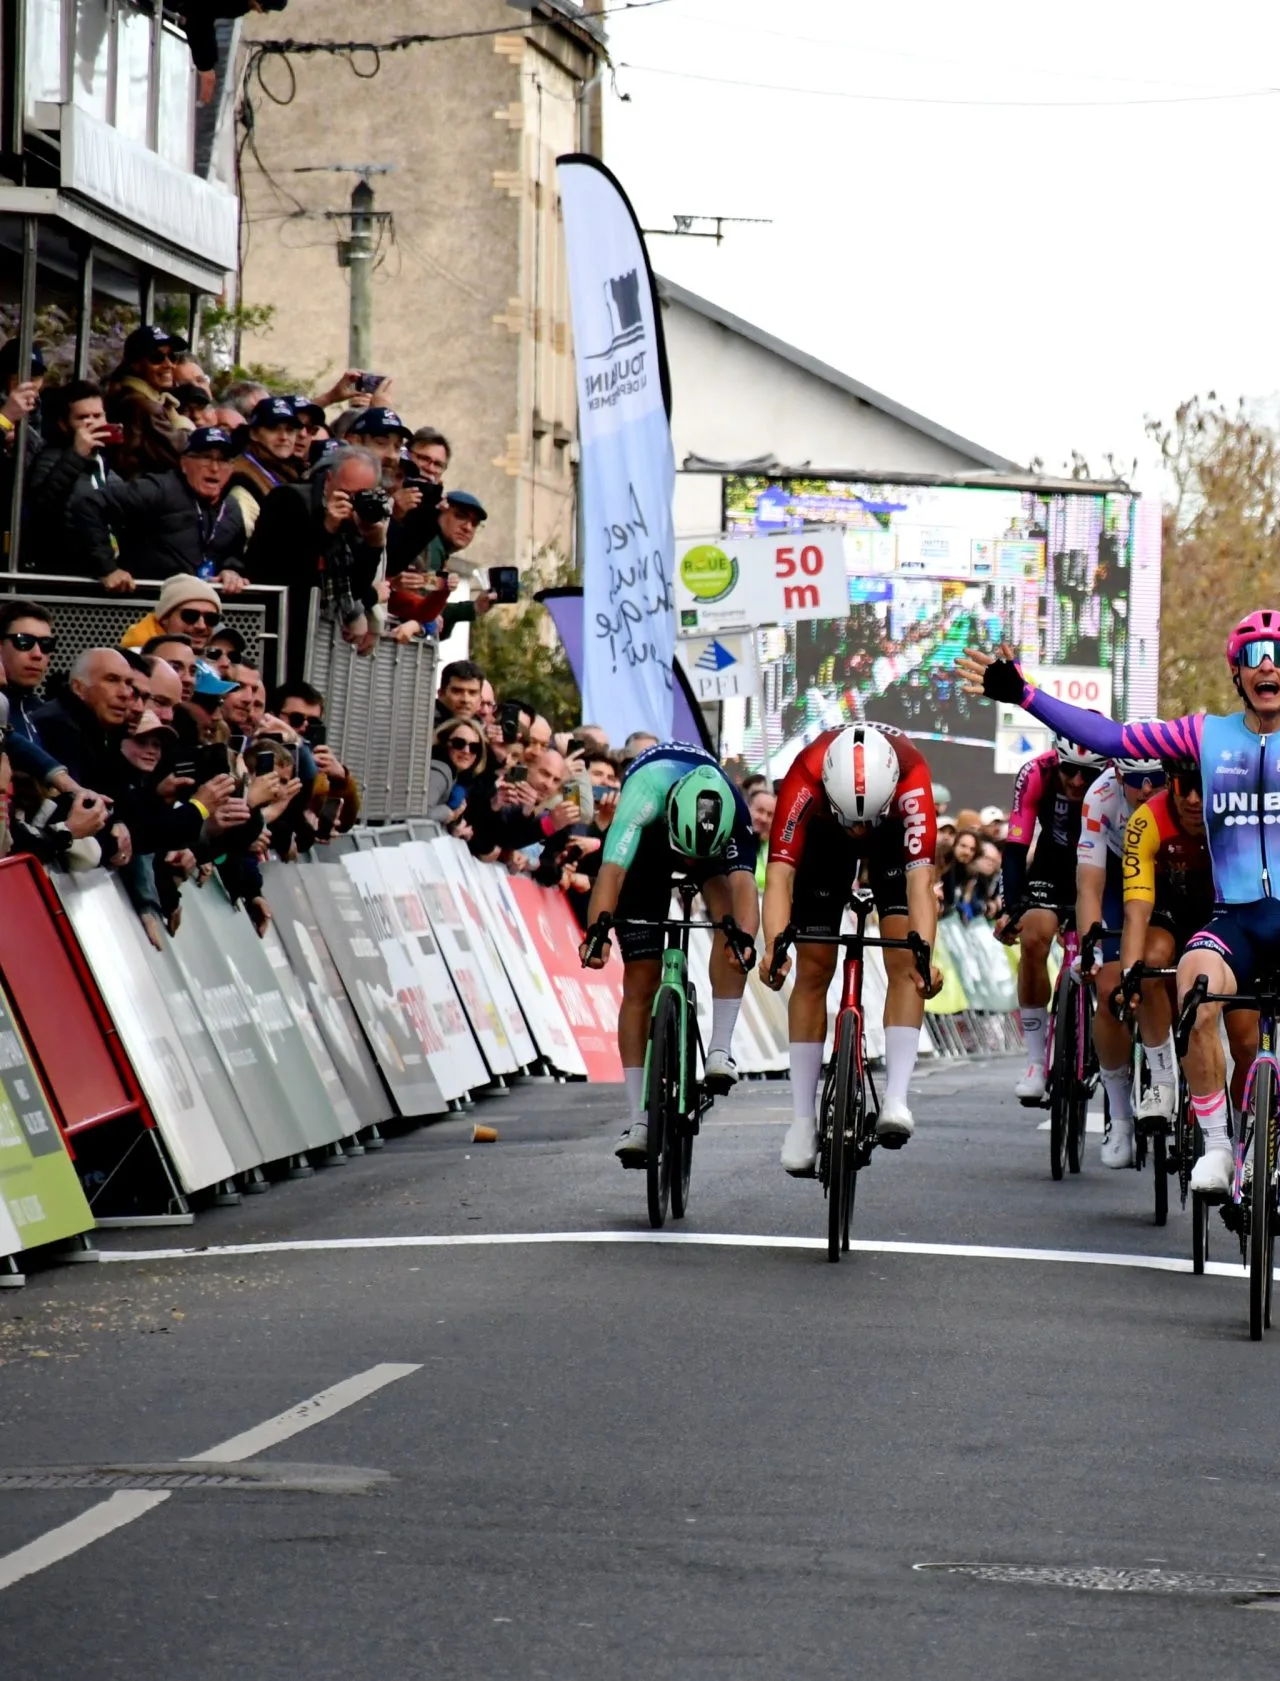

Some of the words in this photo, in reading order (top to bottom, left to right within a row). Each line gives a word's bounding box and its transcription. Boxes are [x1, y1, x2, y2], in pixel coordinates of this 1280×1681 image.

[775, 545, 823, 578] 50
[784, 584, 820, 609] m
[1052, 680, 1099, 701] 100
[898, 787, 926, 855] lotto
